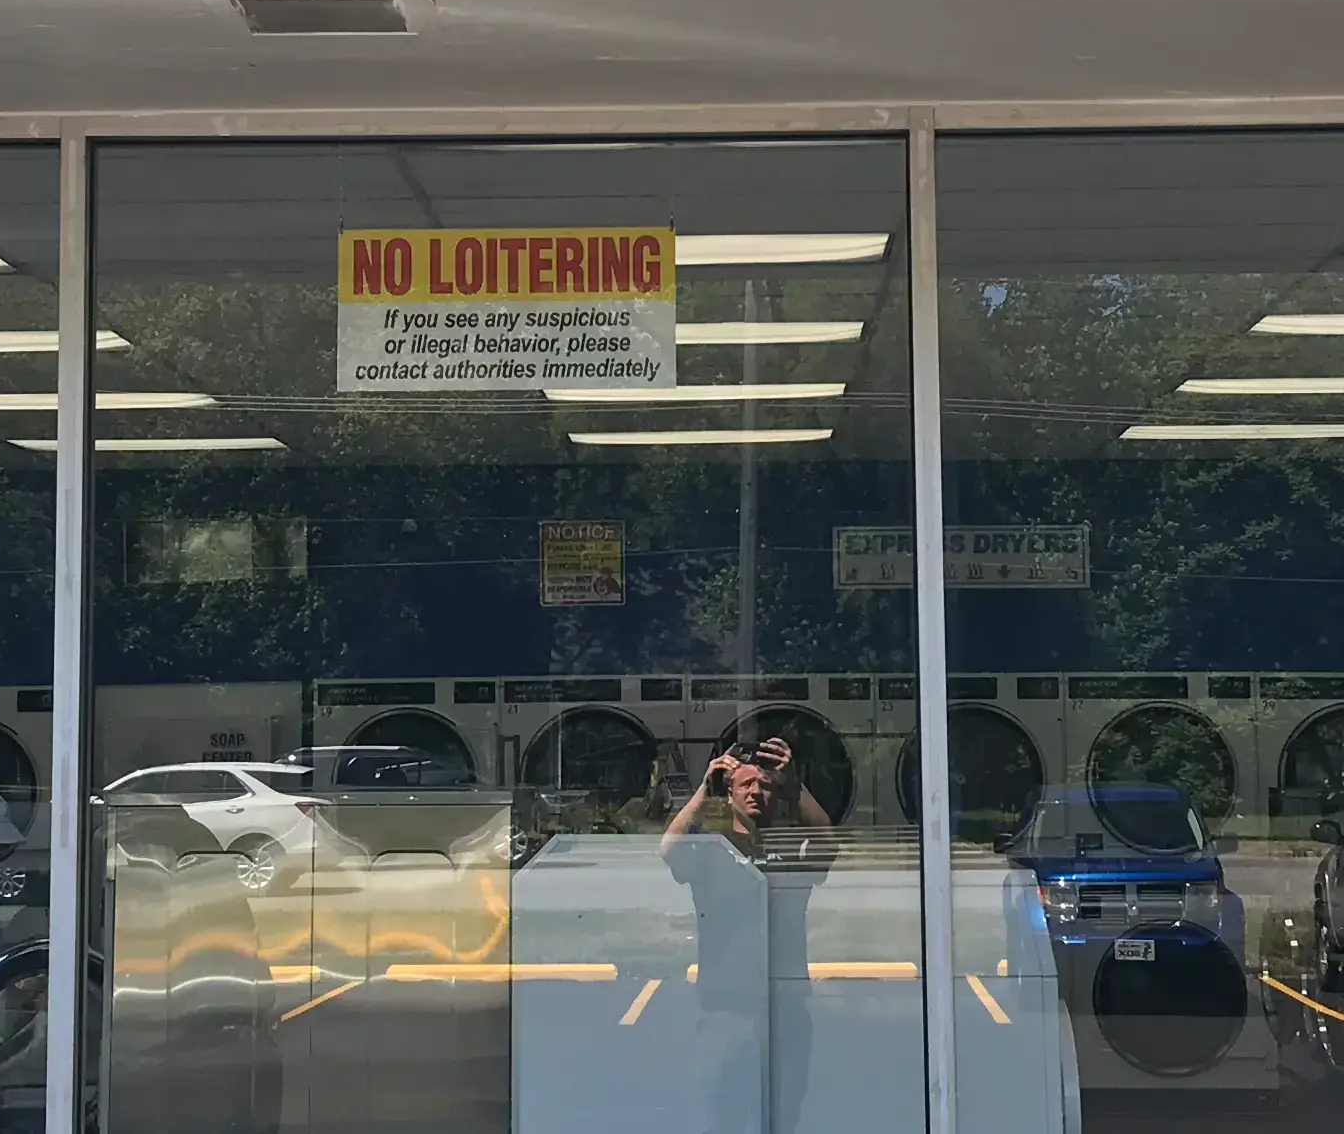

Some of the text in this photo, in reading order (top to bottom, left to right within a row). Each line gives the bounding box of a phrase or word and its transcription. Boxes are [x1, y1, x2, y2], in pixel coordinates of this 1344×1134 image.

[352, 234, 662, 296] NO LOITERING
[384, 307, 631, 333] If you see any suspicious
[384, 333, 631, 357] or illegal behavior, please
[355, 357, 661, 382] contact authorities immediately
[548, 524, 617, 540] NOTICE
[845, 533, 1078, 556] EXPRS DRYERS
[210, 732, 246, 747] SOAP
